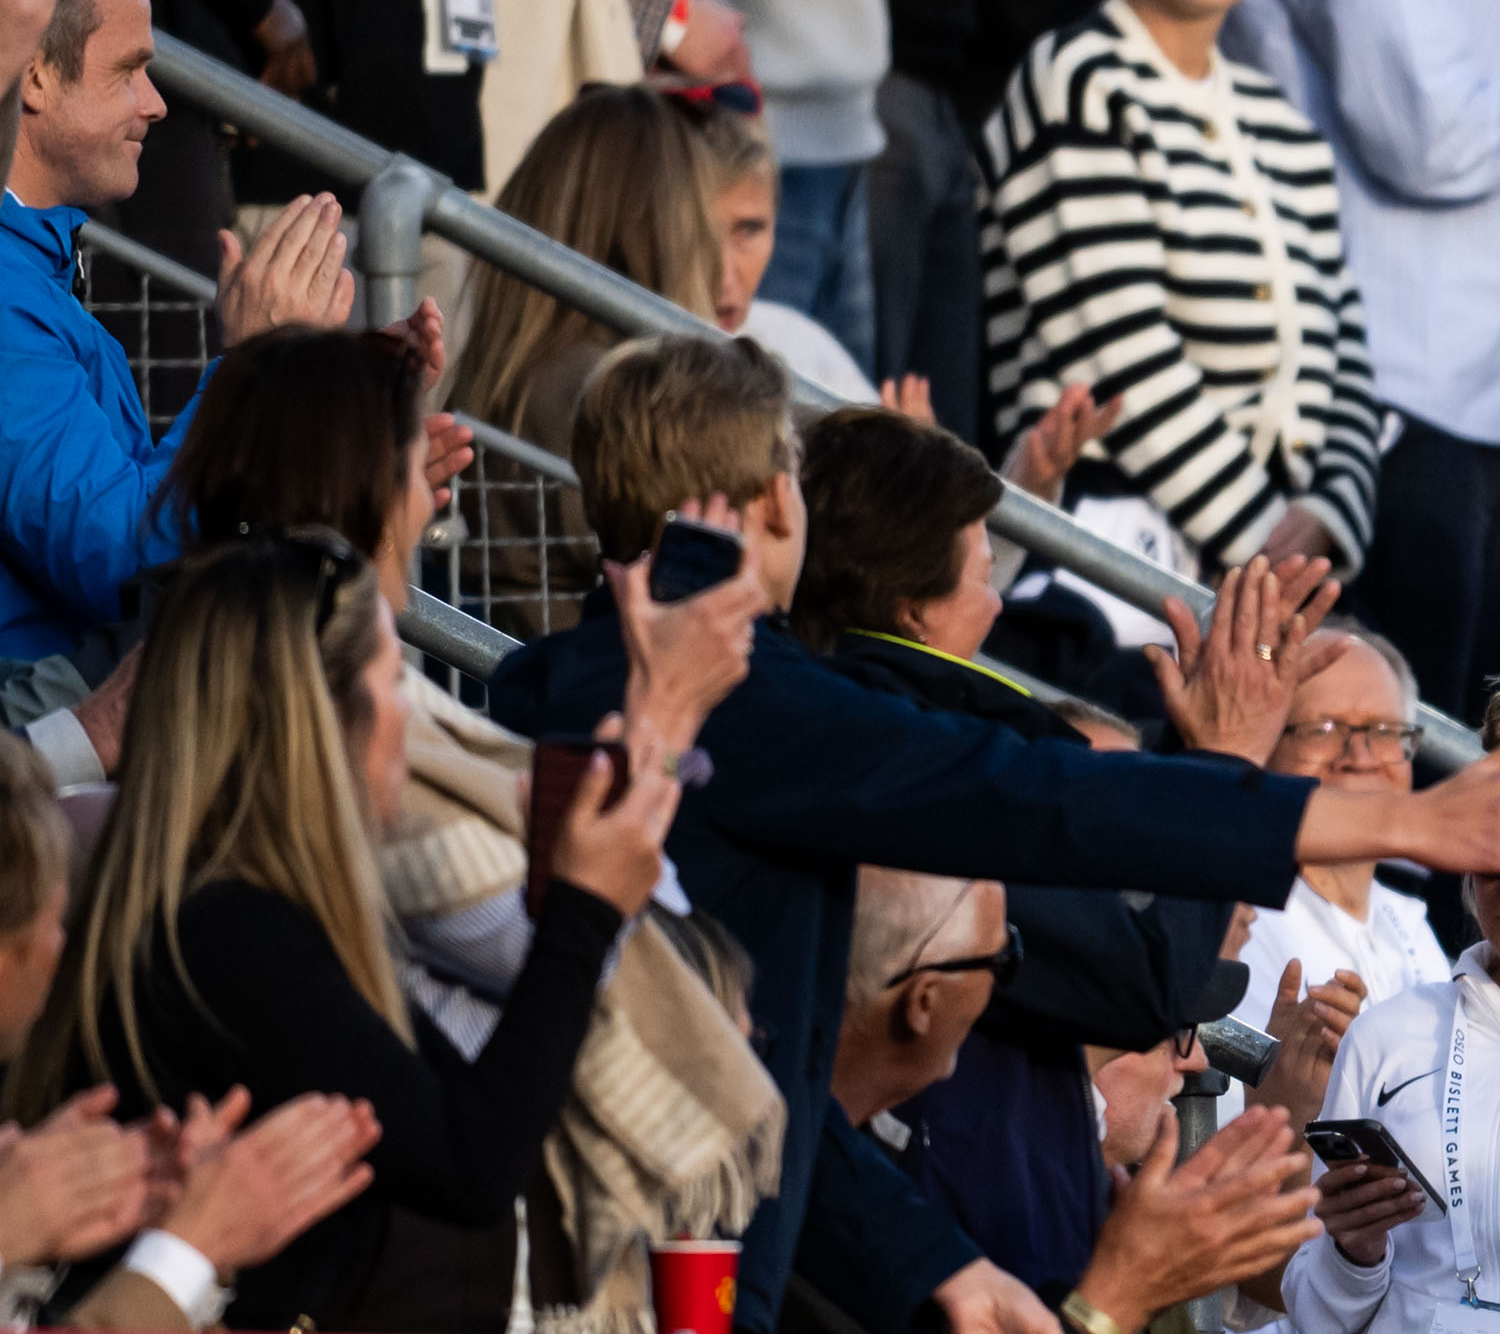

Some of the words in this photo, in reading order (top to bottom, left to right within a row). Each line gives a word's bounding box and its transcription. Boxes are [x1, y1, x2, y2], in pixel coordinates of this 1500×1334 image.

[1451, 1028, 1465, 1066] OSLO
[1445, 1070, 1462, 1135] BISLETT
[1445, 1141, 1463, 1208] GAMES
